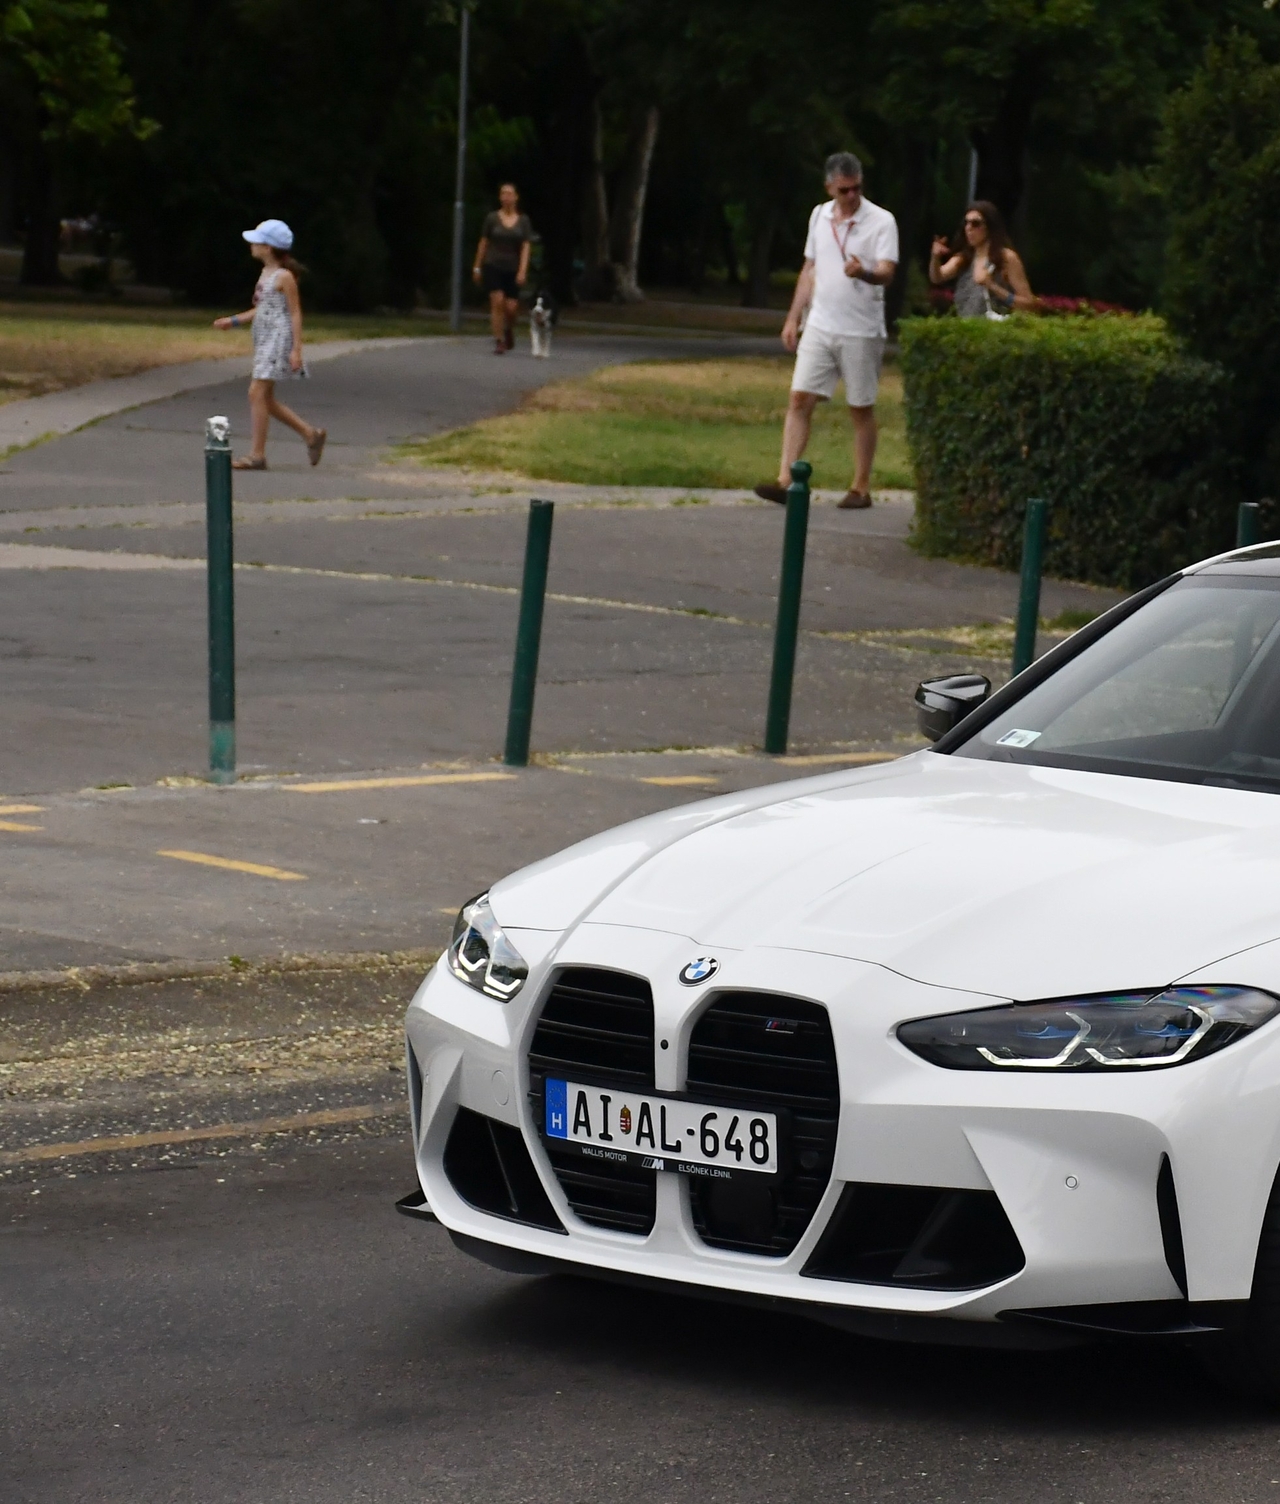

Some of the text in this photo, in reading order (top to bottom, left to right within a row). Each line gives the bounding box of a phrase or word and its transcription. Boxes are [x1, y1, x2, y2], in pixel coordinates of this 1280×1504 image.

[552, 1112, 562, 1130] H
[582, 1147, 628, 1162] WALLIS MOTOR
